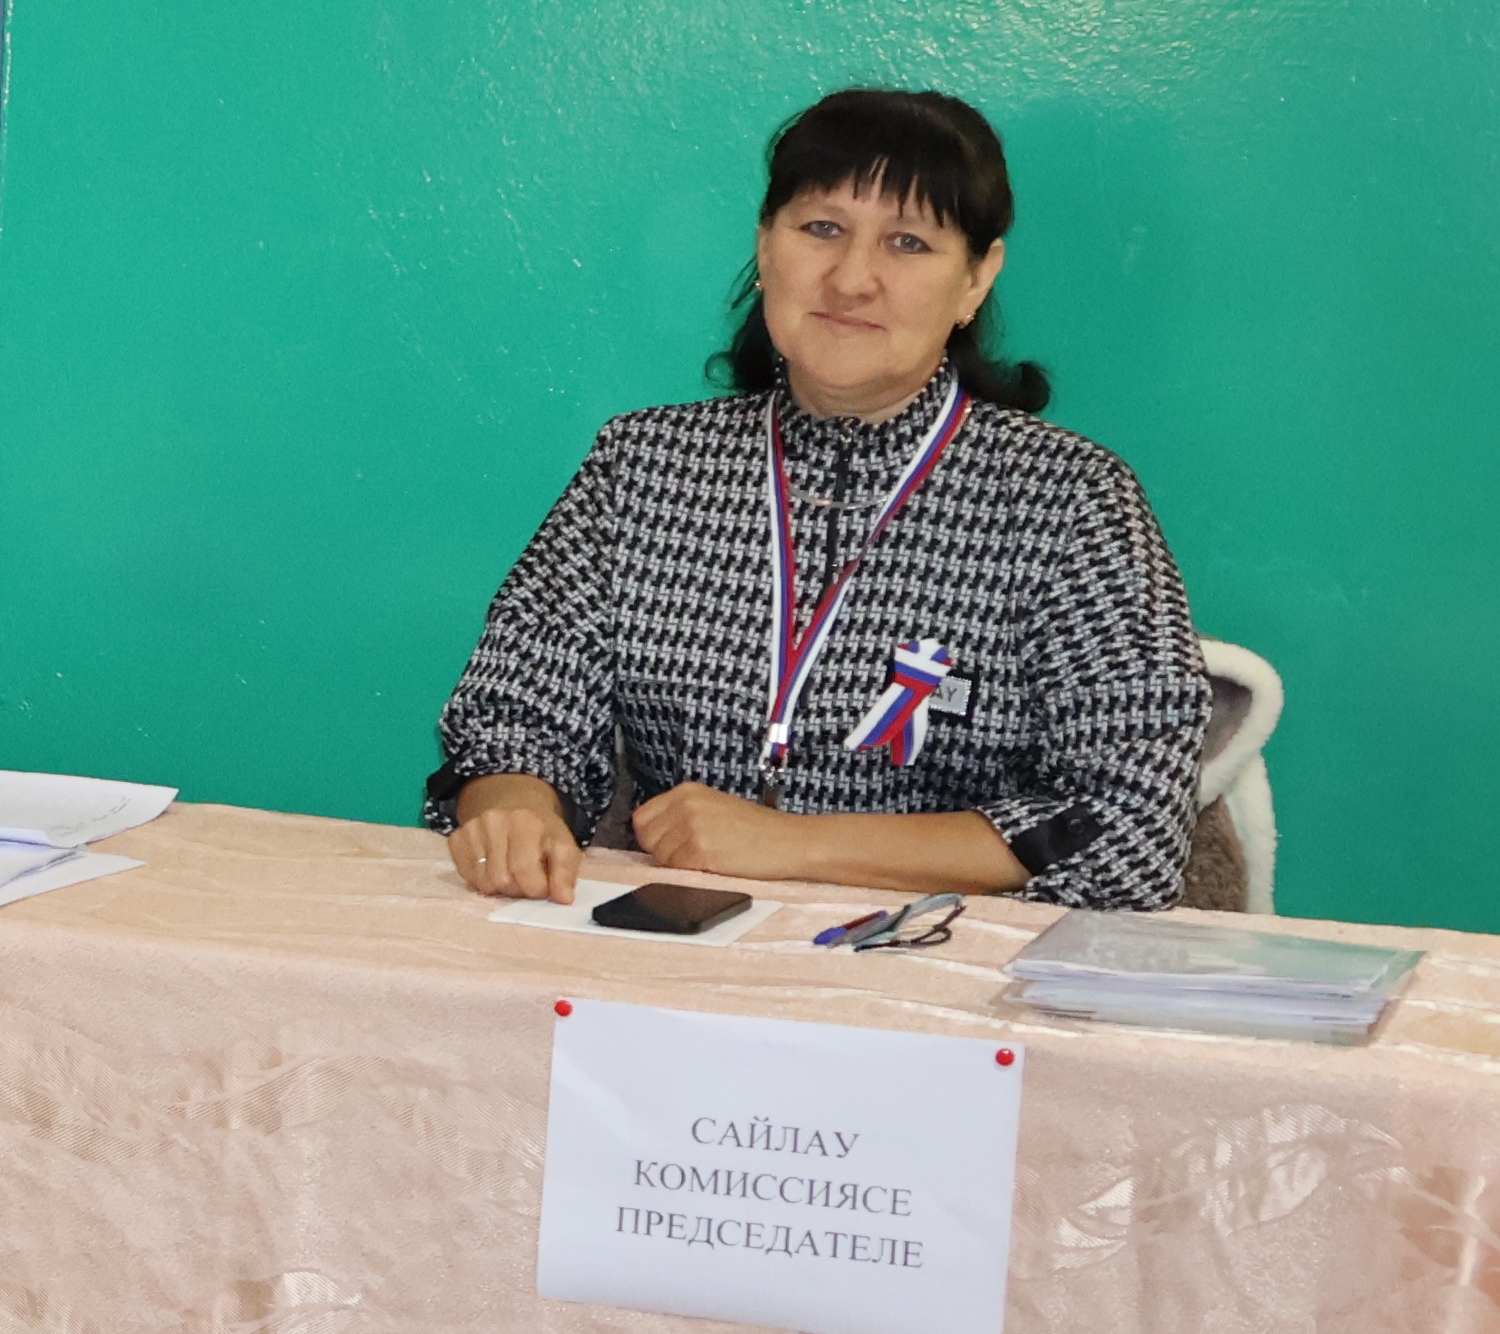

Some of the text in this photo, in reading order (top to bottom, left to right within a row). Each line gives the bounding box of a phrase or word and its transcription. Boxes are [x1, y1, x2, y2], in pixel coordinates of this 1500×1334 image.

[690, 1115, 860, 1160] САЙЛАУ
[633, 1158, 913, 1218] КОМИССИЯСЕ
[614, 1205, 924, 1271] ПРЕДСЕДАТЕЛЕ
